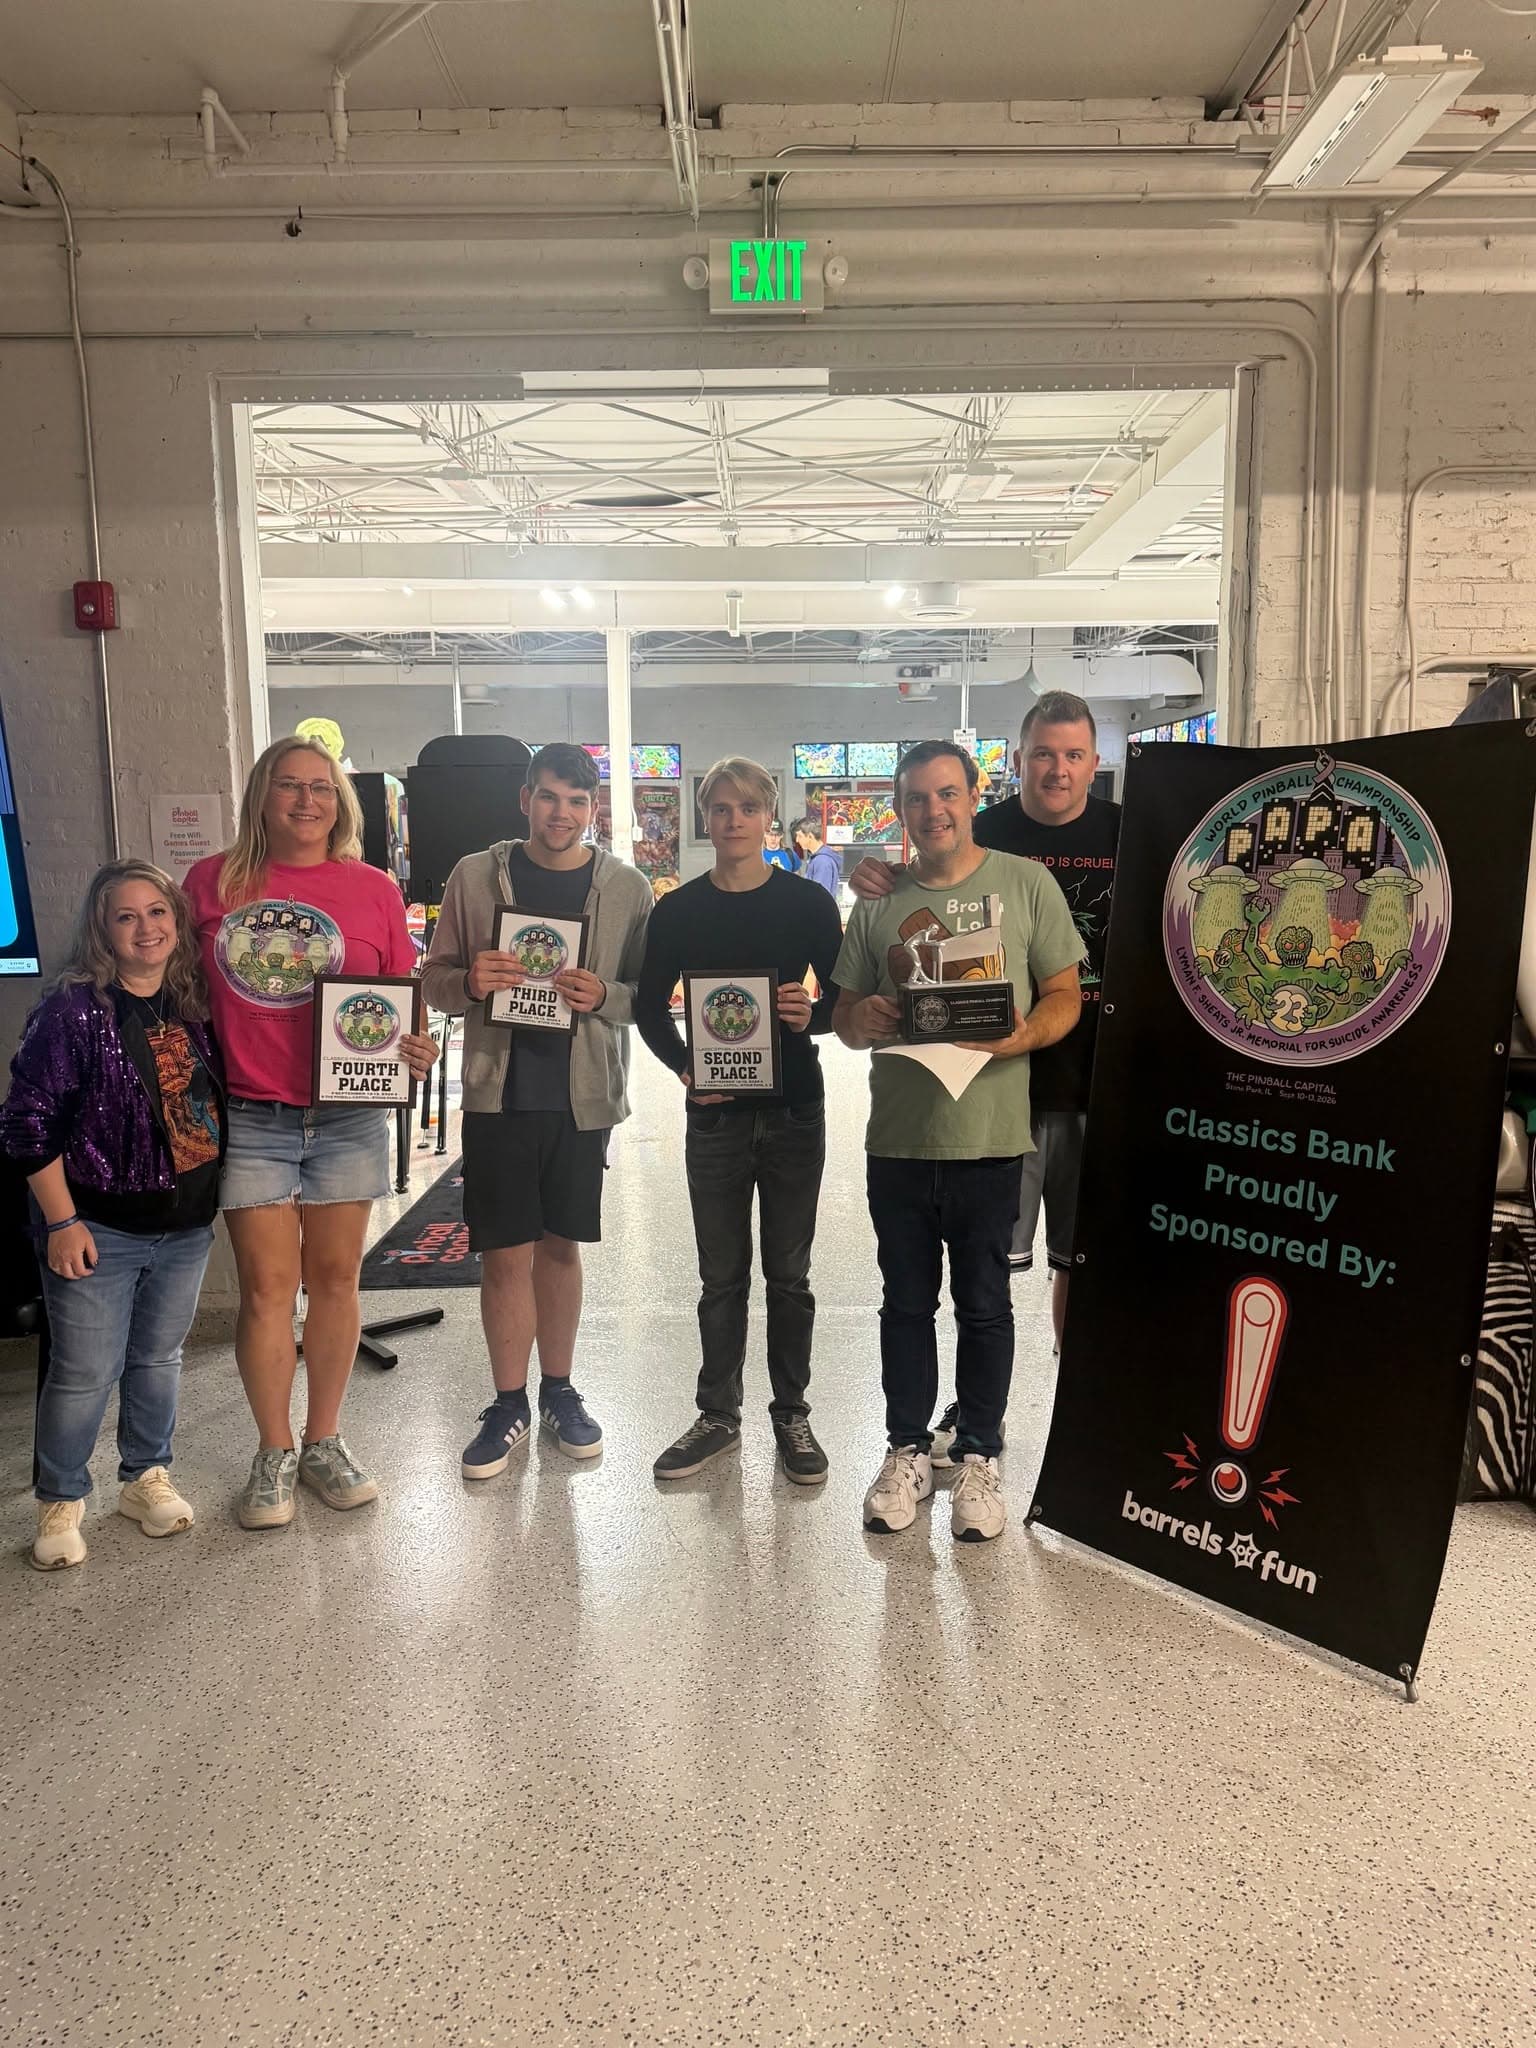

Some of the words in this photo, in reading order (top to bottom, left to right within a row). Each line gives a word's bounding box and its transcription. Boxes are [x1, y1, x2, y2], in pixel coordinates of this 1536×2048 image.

[730, 241, 807, 302] EXIT
[1205, 800, 1248, 842] WORLD
[1252, 775, 1312, 803] PINBALL
[1336, 777, 1421, 841] CHAMPIONSHIP
[1227, 806, 1375, 863] PAPA
[1059, 857, 1071, 867] IS
[511, 986, 557, 1003] THIRD
[713, 993, 744, 1006] PAPA
[1176, 946, 1196, 986] LYMAN
[1192, 985, 1201, 994] F.
[1199, 995, 1231, 1028] SHEATS
[1231, 1025, 1244, 1038] JR.
[1247, 1033, 1302, 1053] MEMORIAL
[1305, 1042, 1328, 1051] FOR
[1329, 1024, 1370, 1048] SUICIDE
[1371, 963, 1423, 1028] AWARENESS
[349, 1000, 383, 1013] PAPA
[509, 1001, 557, 1018] PLACE
[1270, 989, 1308, 1033] 23
[704, 1051, 762, 1064] SECOND
[332, 1062, 399, 1076] FOURTH
[710, 1067, 757, 1079] PLACE
[338, 1078, 391, 1091] PLACE
[1226, 1072, 1246, 1082] THE
[1248, 1074, 1292, 1088] PINBALL
[1294, 1080, 1336, 1094] CAPITAL
[1265, 1087, 1272, 1095] IL
[1165, 1107, 1297, 1154] Classics
[1307, 1129, 1396, 1172] Bank
[1205, 1164, 1338, 1223] Proudly
[1149, 1203, 1328, 1269] Sponsored
[1339, 1244, 1397, 1289] By:
[1121, 1490, 1224, 1555] barrels
[1236, 1543, 1252, 1563] of
[1260, 1551, 1318, 1594] fun
